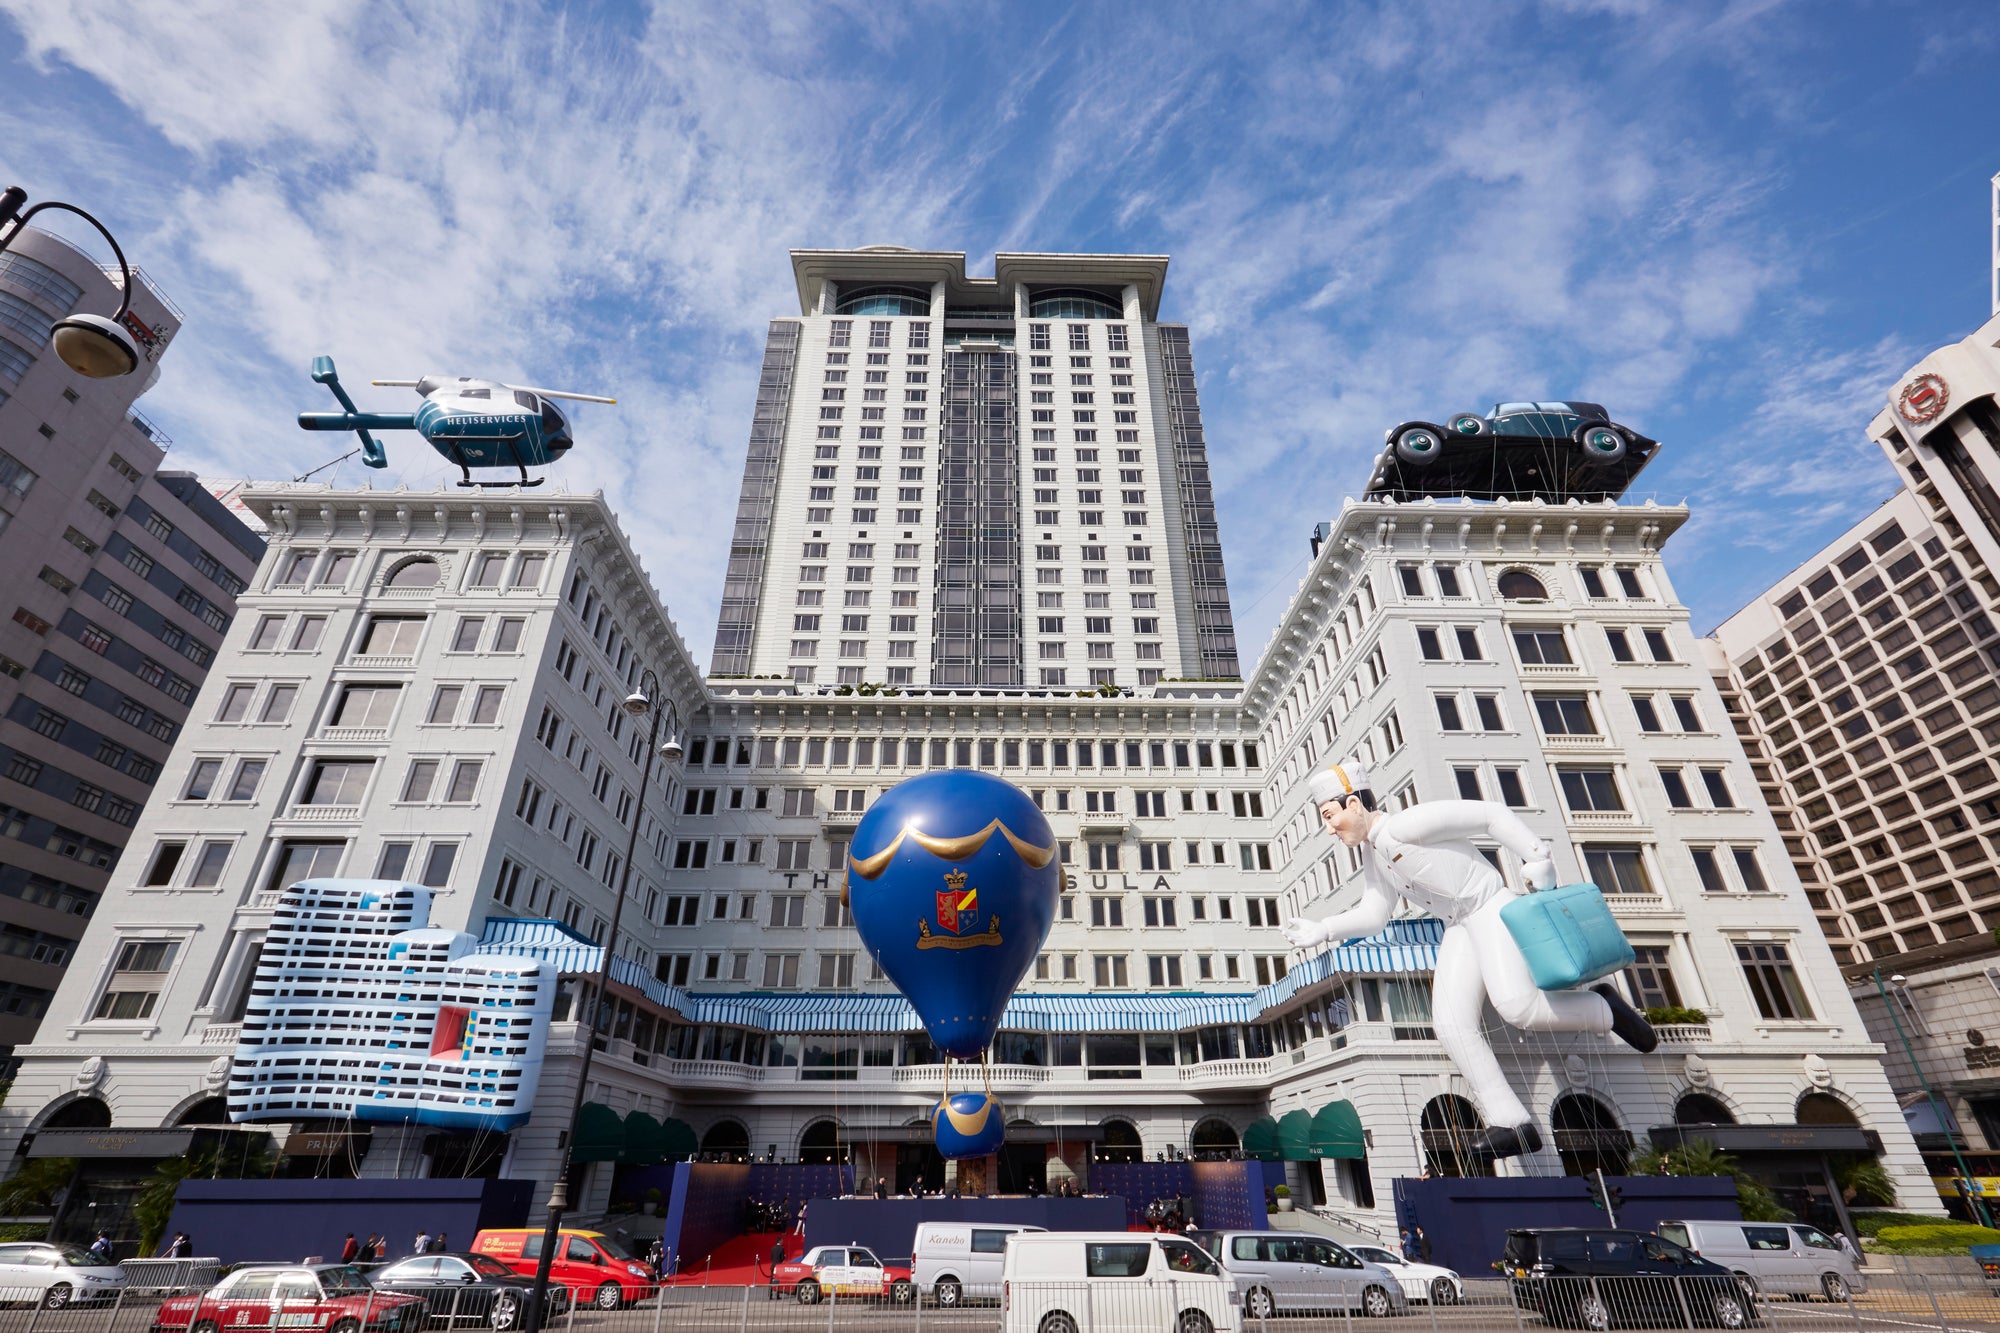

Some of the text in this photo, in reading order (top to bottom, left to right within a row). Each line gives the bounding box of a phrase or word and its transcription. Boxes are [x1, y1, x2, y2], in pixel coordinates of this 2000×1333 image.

[447, 415, 526, 426] HELISERVICES
[784, 873, 829, 889] TH
[929, 1235, 965, 1245] Kanebo
